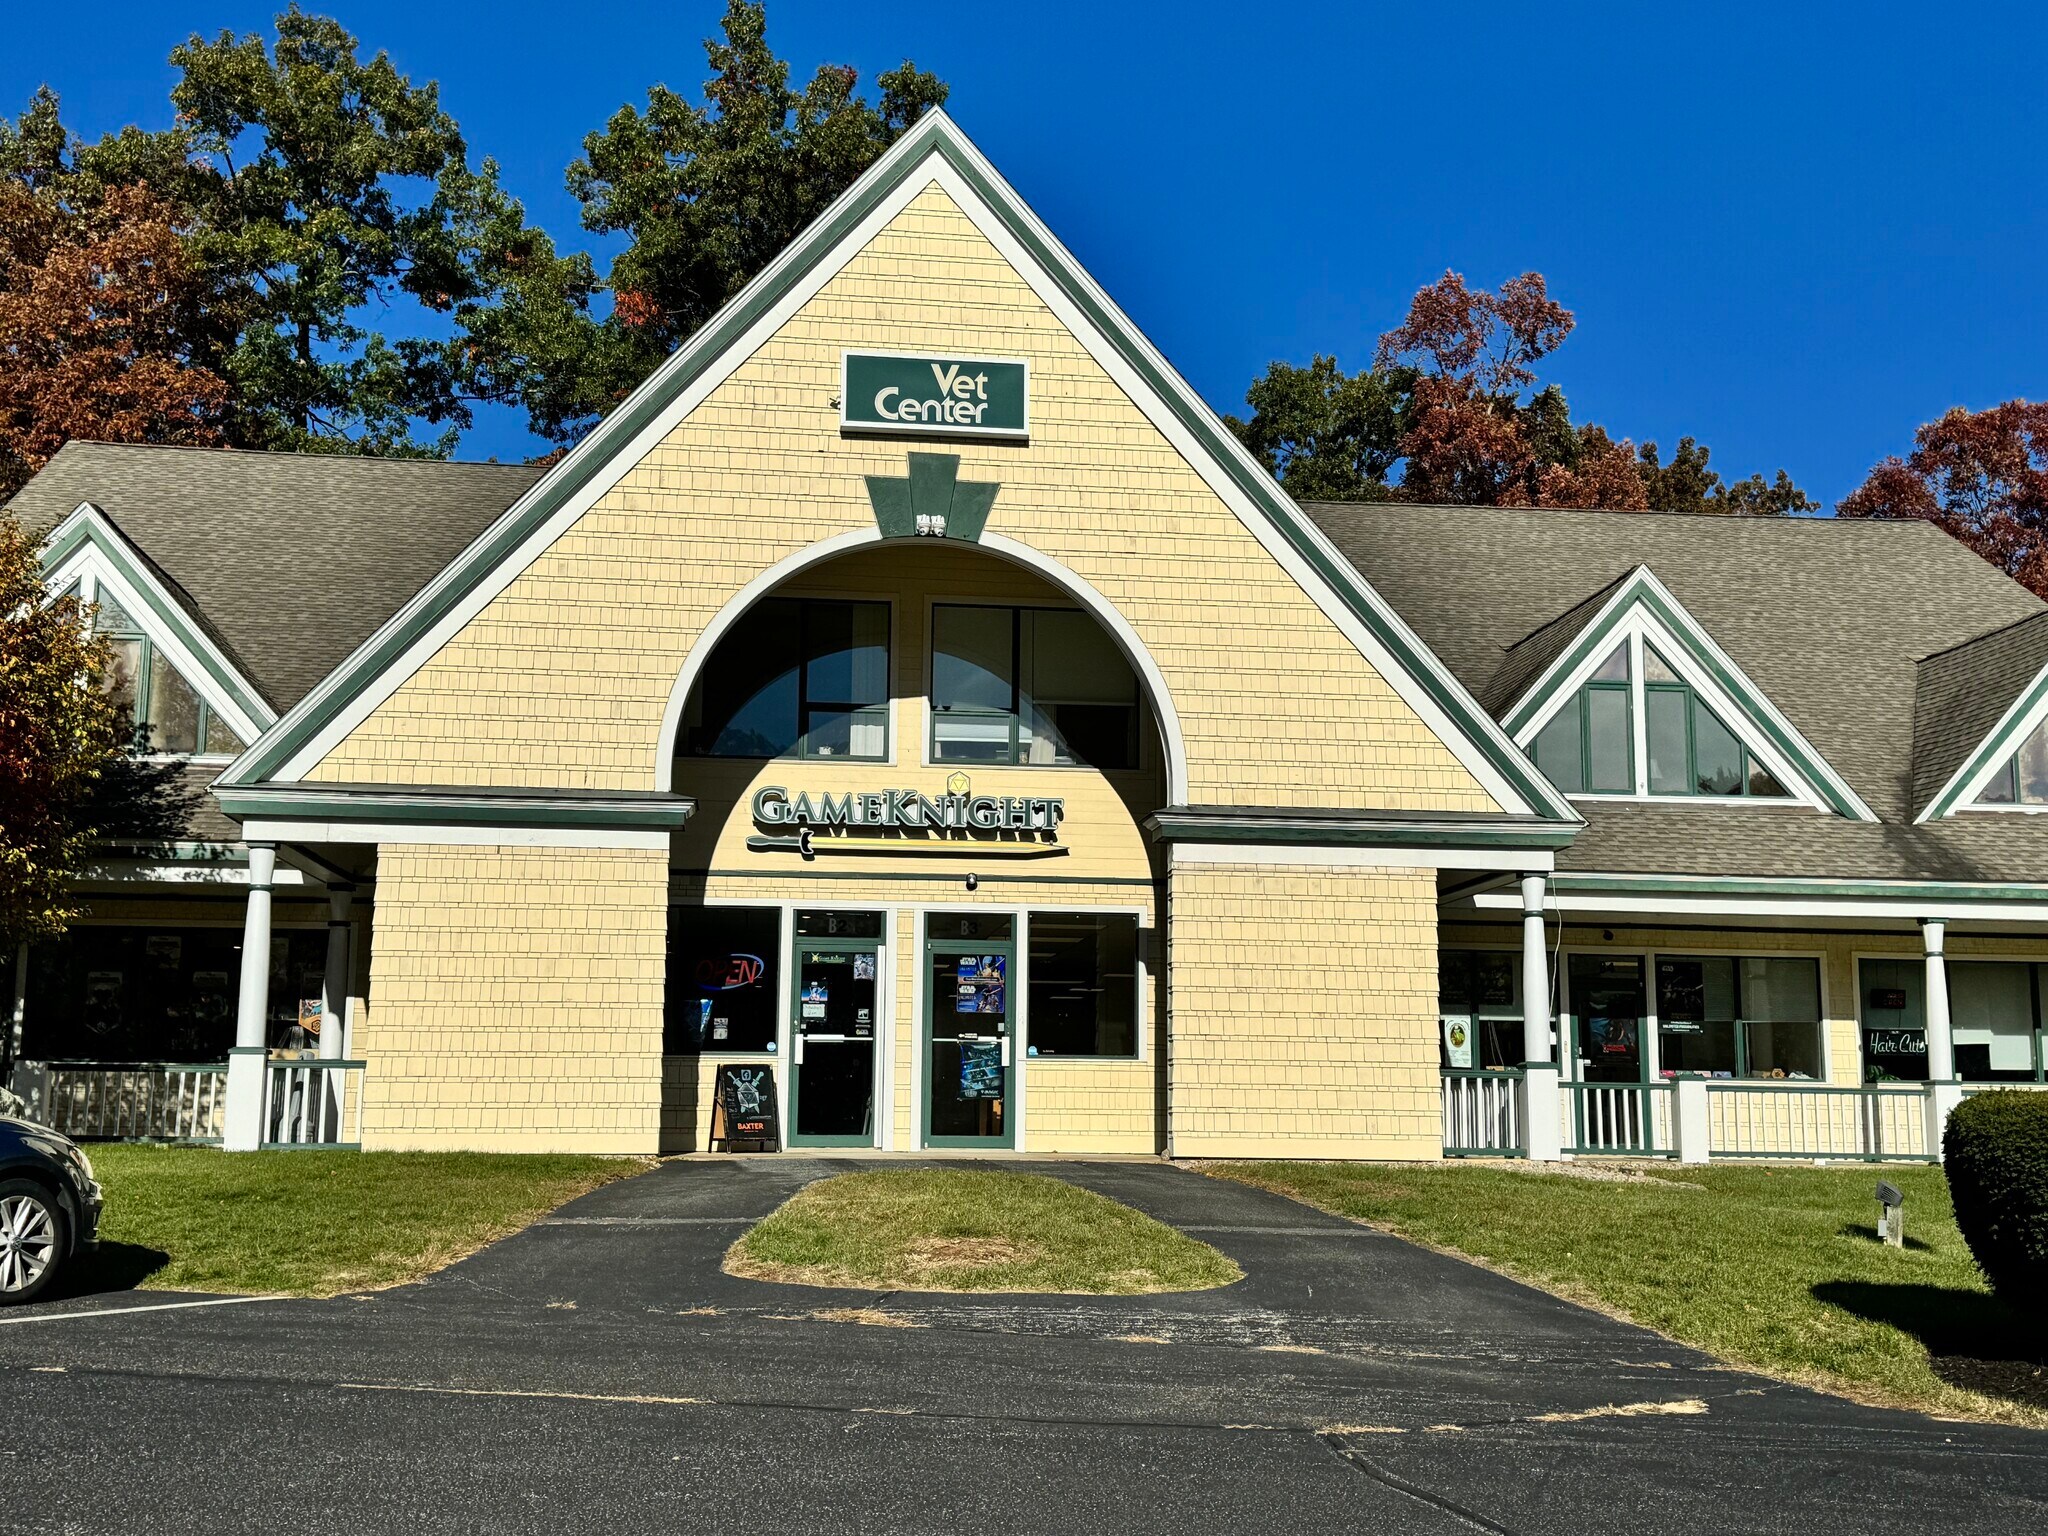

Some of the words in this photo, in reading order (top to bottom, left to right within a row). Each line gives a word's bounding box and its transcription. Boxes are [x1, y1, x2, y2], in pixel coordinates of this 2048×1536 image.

[930, 363, 989, 400] Vet
[874, 386, 988, 424] Center
[695, 959, 758, 985] OPEN
[1870, 1032, 1898, 1055] Hair
[1899, 1033, 1926, 1053] Cuts
[737, 1122, 764, 1130] BAXTER
